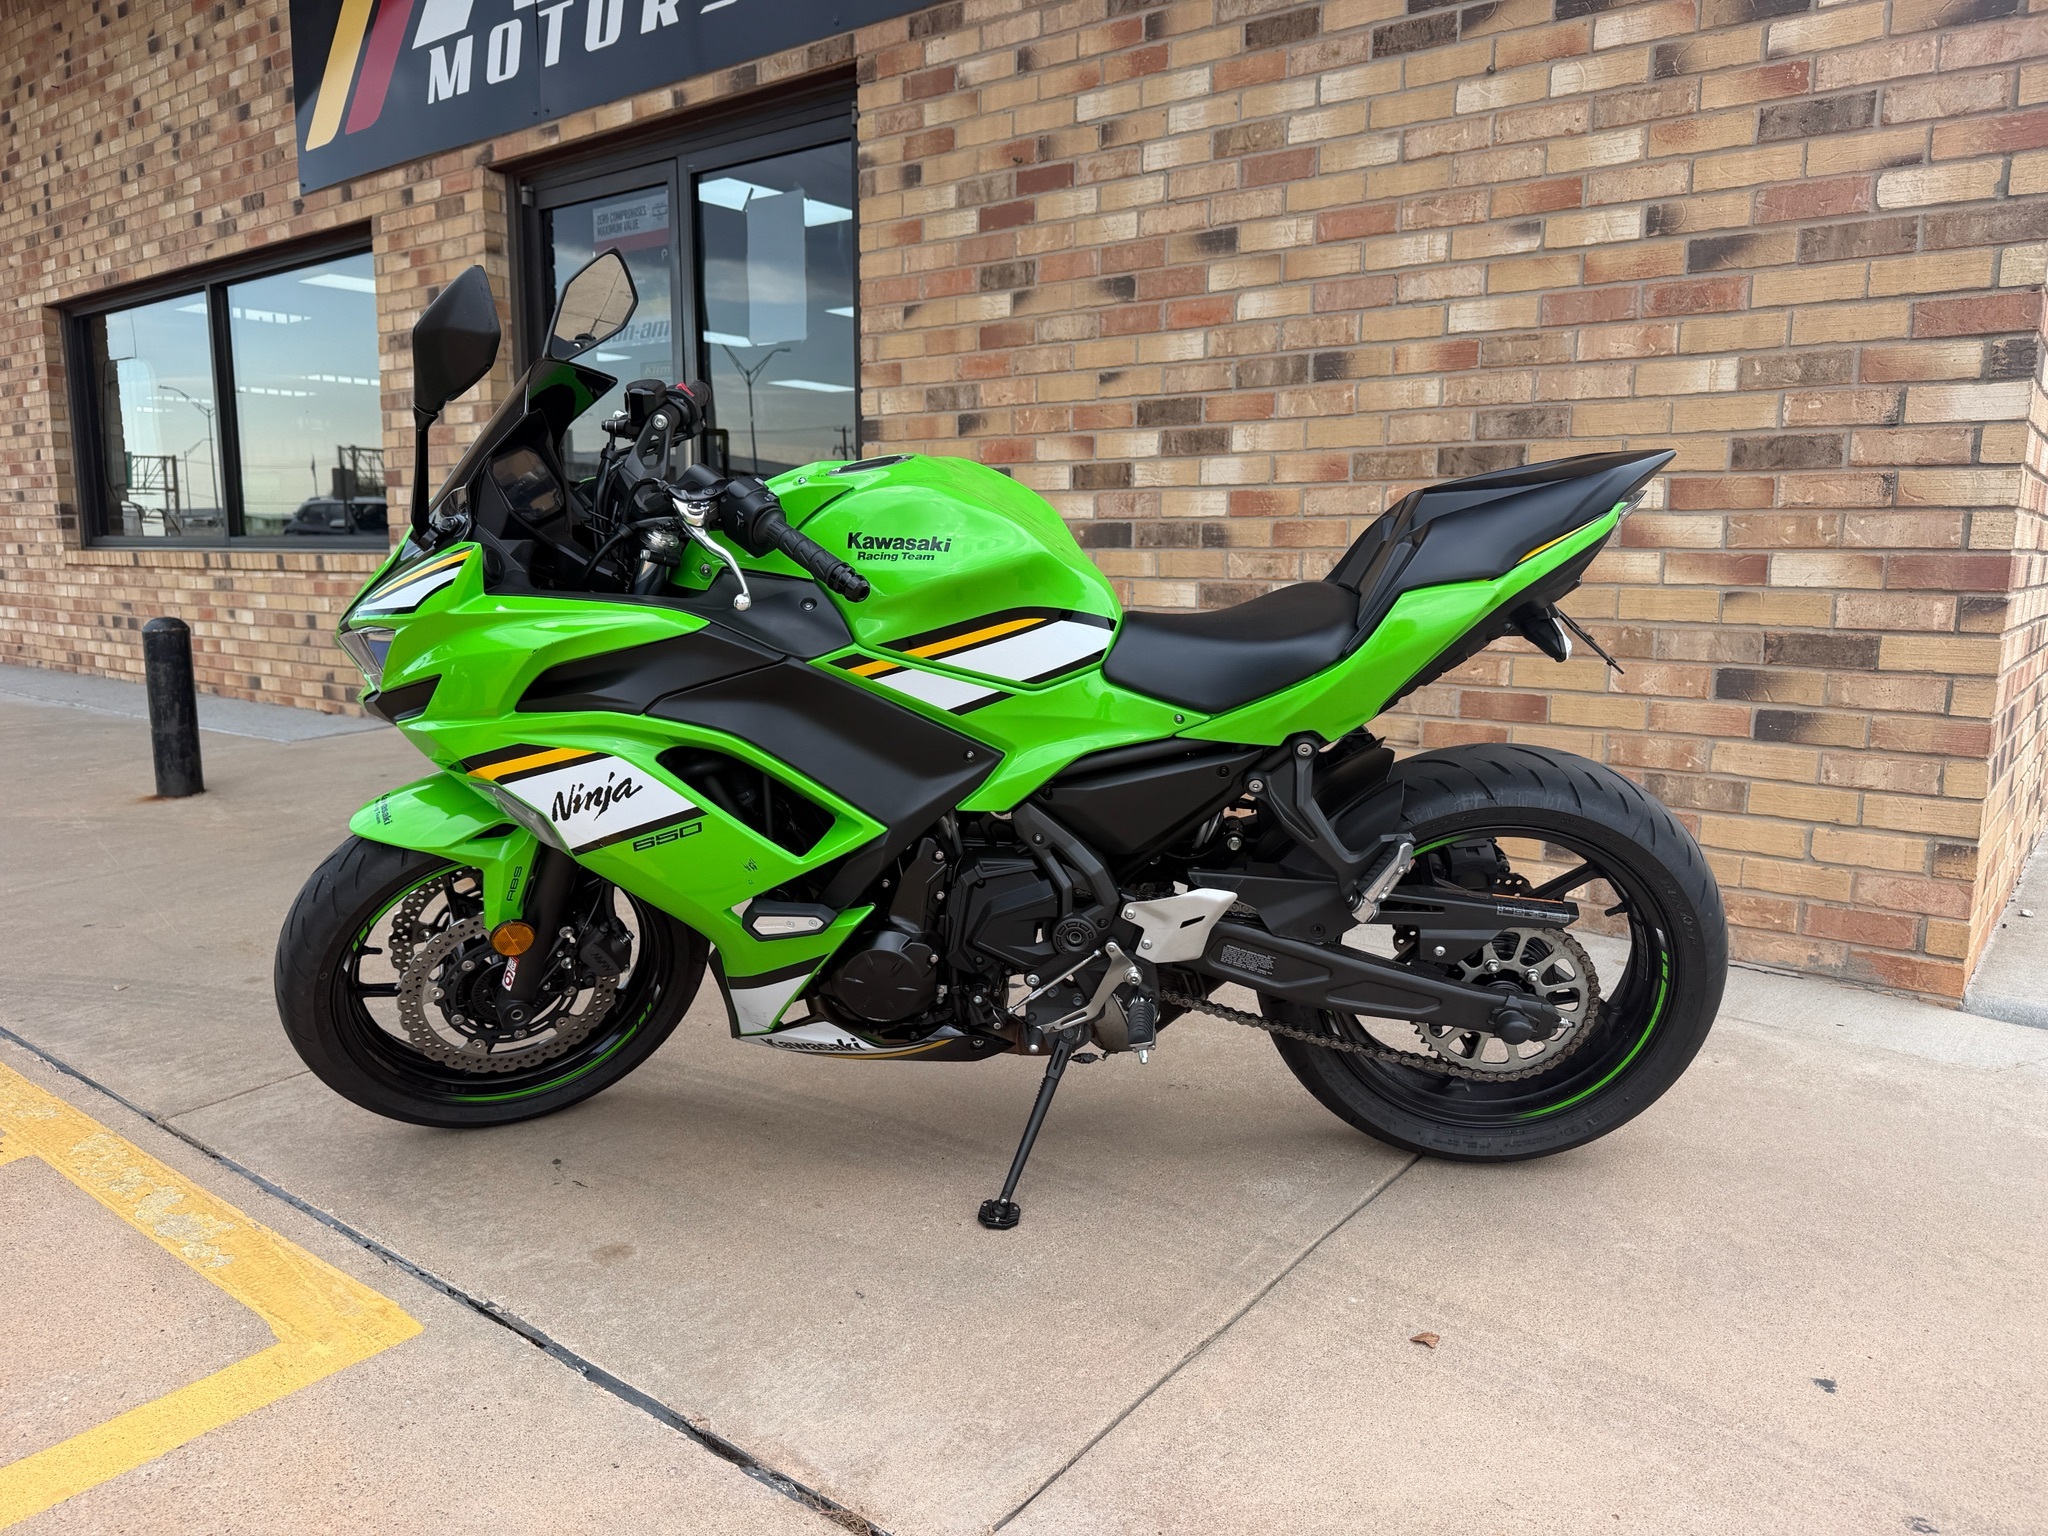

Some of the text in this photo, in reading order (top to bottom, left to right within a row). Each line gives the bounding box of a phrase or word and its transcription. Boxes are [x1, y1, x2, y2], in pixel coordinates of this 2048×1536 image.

[427, 0, 738, 105] MOTOR
[624, 219, 640, 232] VALUE
[607, 320, 671, 343] an-am
[847, 532, 952, 552] Kawasaki
[857, 551, 935, 561] Racing Team
[552, 771, 643, 822] Ninja
[633, 822, 702, 851] 650
[506, 866, 523, 901] ABS
[759, 1037, 866, 1051] Kawasaki
